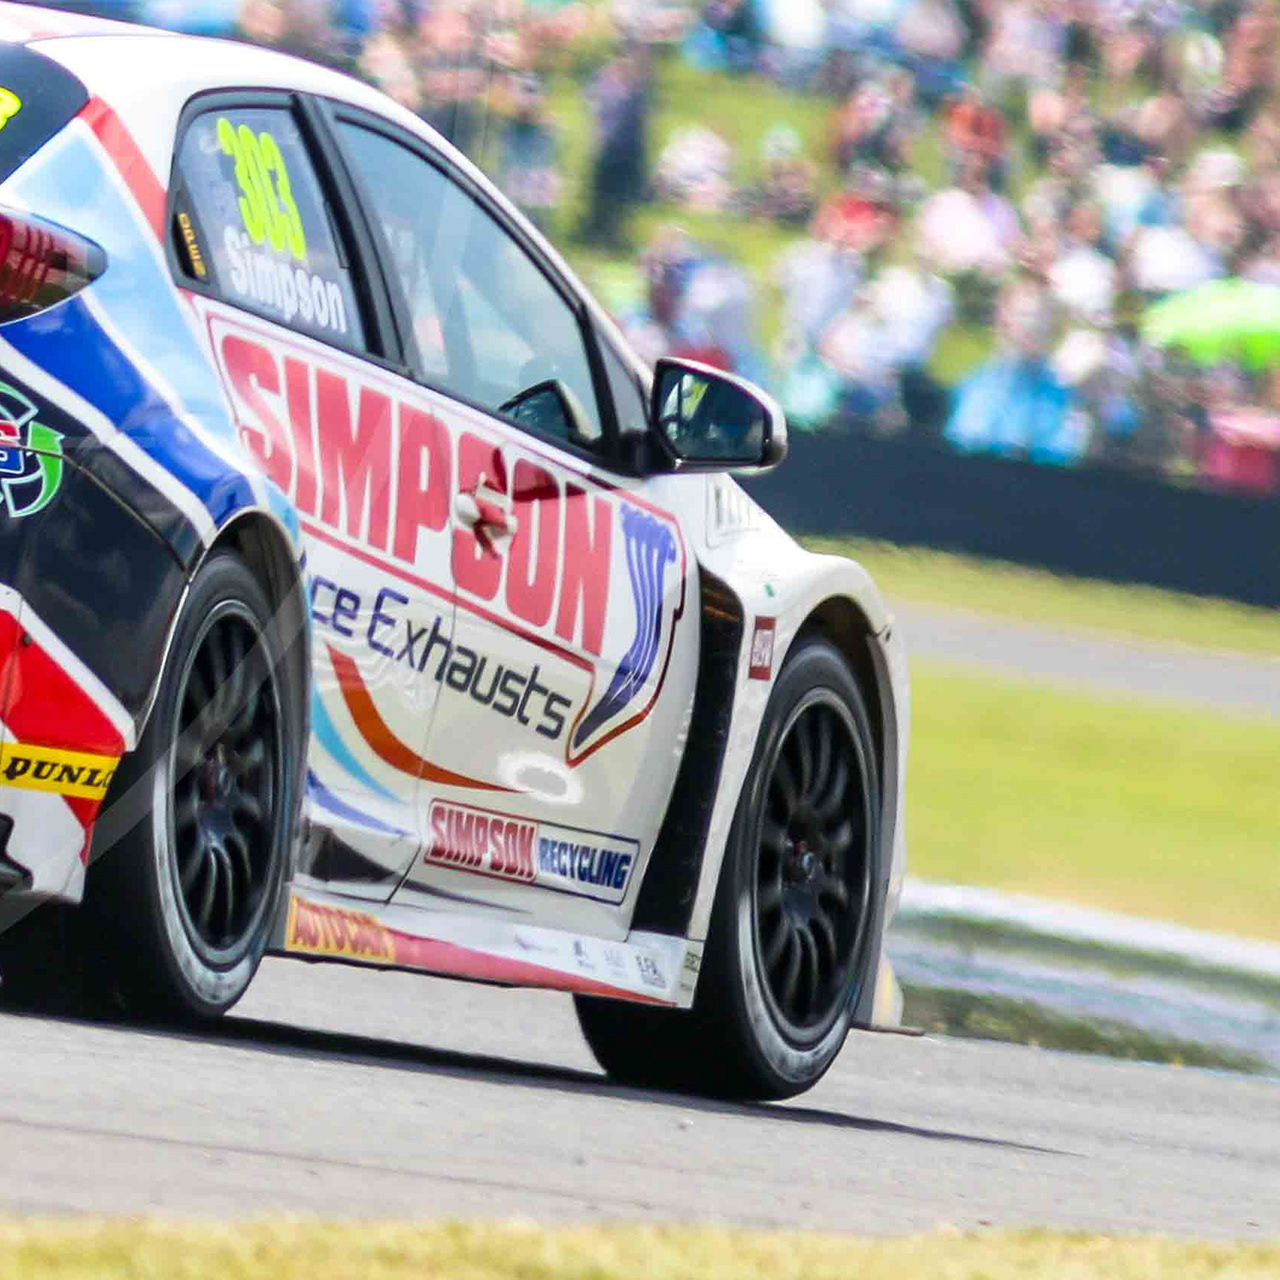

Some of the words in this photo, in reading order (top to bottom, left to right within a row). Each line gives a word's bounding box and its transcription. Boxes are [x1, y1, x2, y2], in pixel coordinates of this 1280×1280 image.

[223, 225, 347, 334] Simpson
[221, 333, 613, 659] SIMPSON
[367, 586, 572, 741] Exhausts
[428, 804, 537, 878] SIMPSON
[539, 837, 632, 890] RECYCLING
